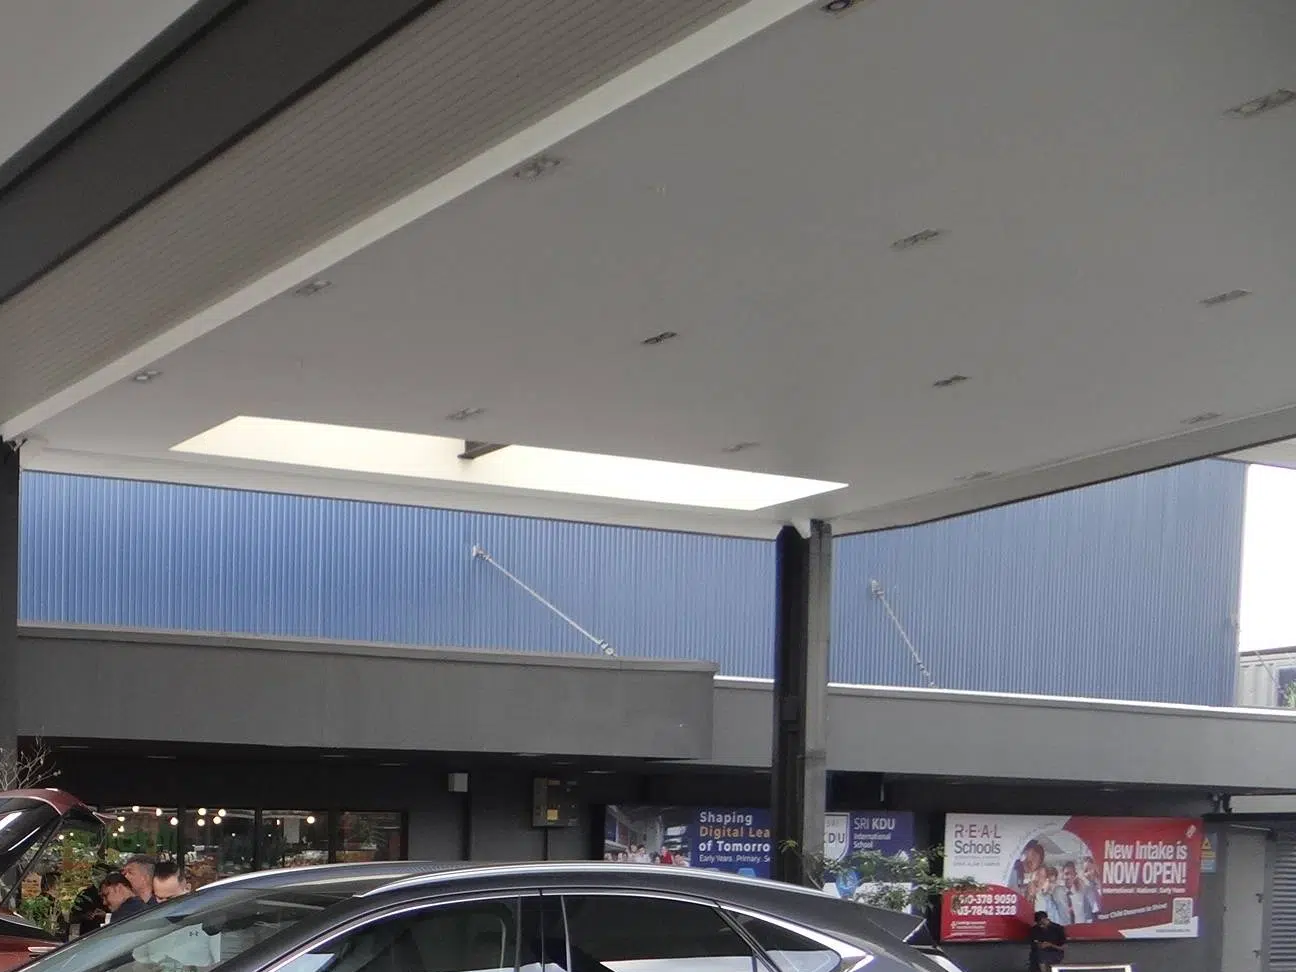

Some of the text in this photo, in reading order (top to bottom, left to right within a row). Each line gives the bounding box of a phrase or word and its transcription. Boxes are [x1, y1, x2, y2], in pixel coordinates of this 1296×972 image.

[700, 811, 753, 826] Shaping
[853, 817, 896, 830] SRI KDU
[700, 826, 771, 840] Digital Lea
[822, 832, 845, 844] DU
[699, 840, 771, 852] of Tomorro
[853, 840, 874, 849] School
[954, 840, 1001, 855] Schools
[1104, 840, 1188, 859] New Intake is
[1103, 861, 1141, 884] NOW
[1142, 861, 1187, 884] OPEN!
[994, 894, 1017, 904] 9050
